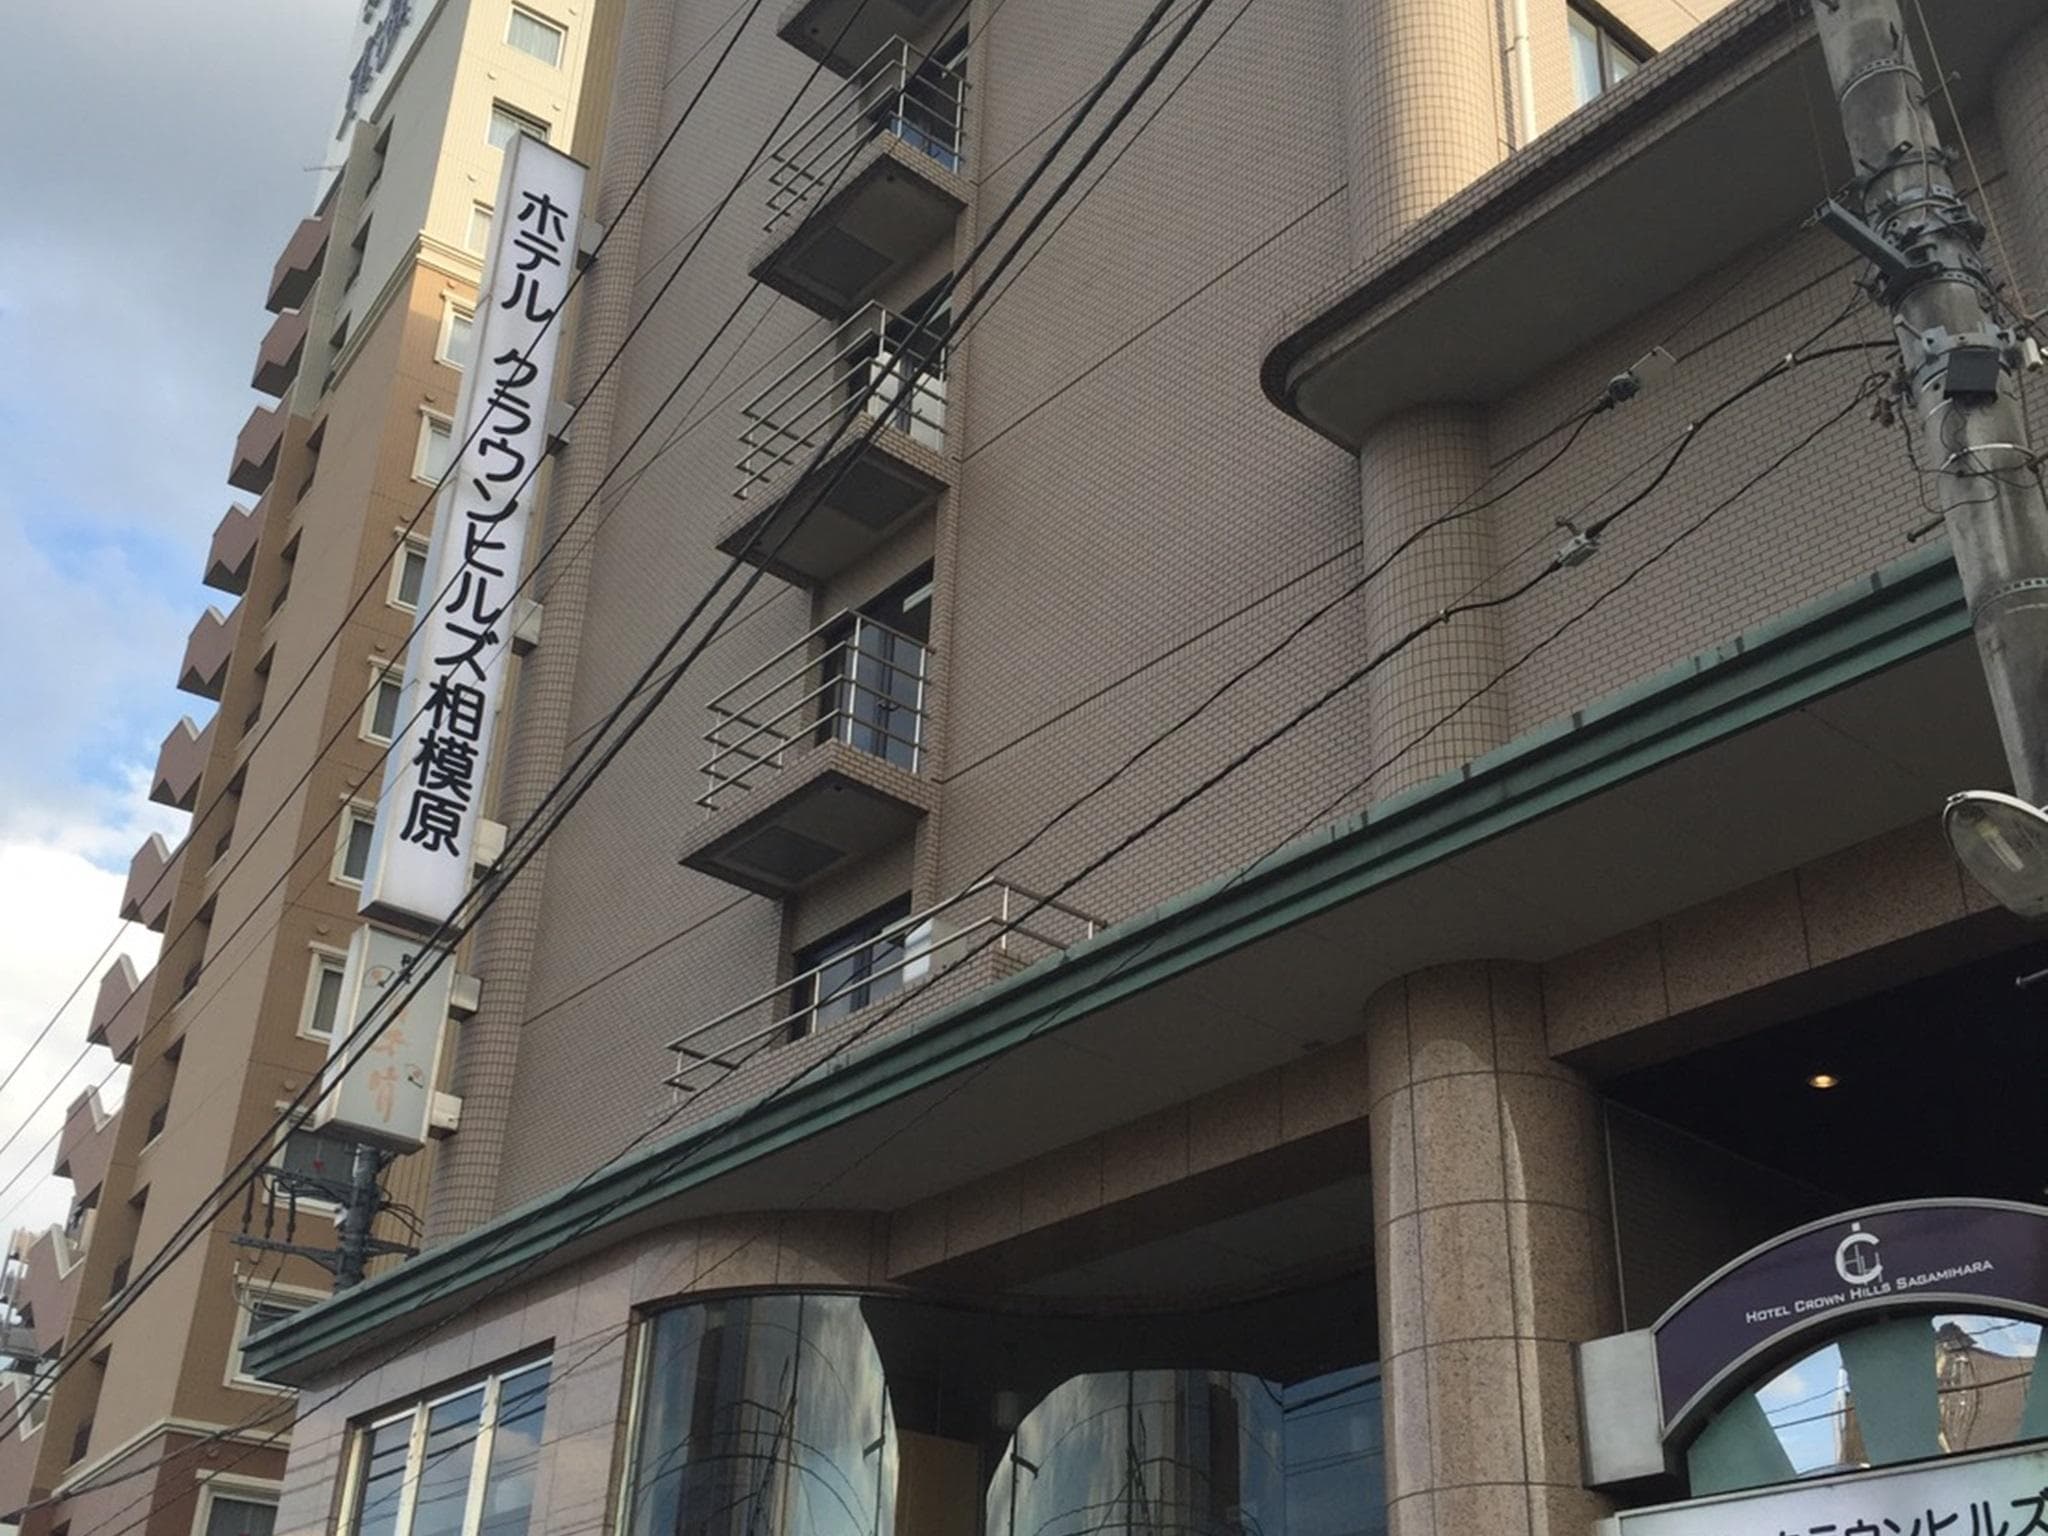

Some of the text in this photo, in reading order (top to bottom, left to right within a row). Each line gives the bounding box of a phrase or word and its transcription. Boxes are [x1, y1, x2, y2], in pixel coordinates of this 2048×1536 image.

[400, 191, 569, 857] ホテル クラウンヒルズ相模原
[1745, 1259, 1995, 1324] HOTEL CROWN HILLS SAGAMIHARA
[1778, 1486, 2048, 1536] ウンヒルズ
